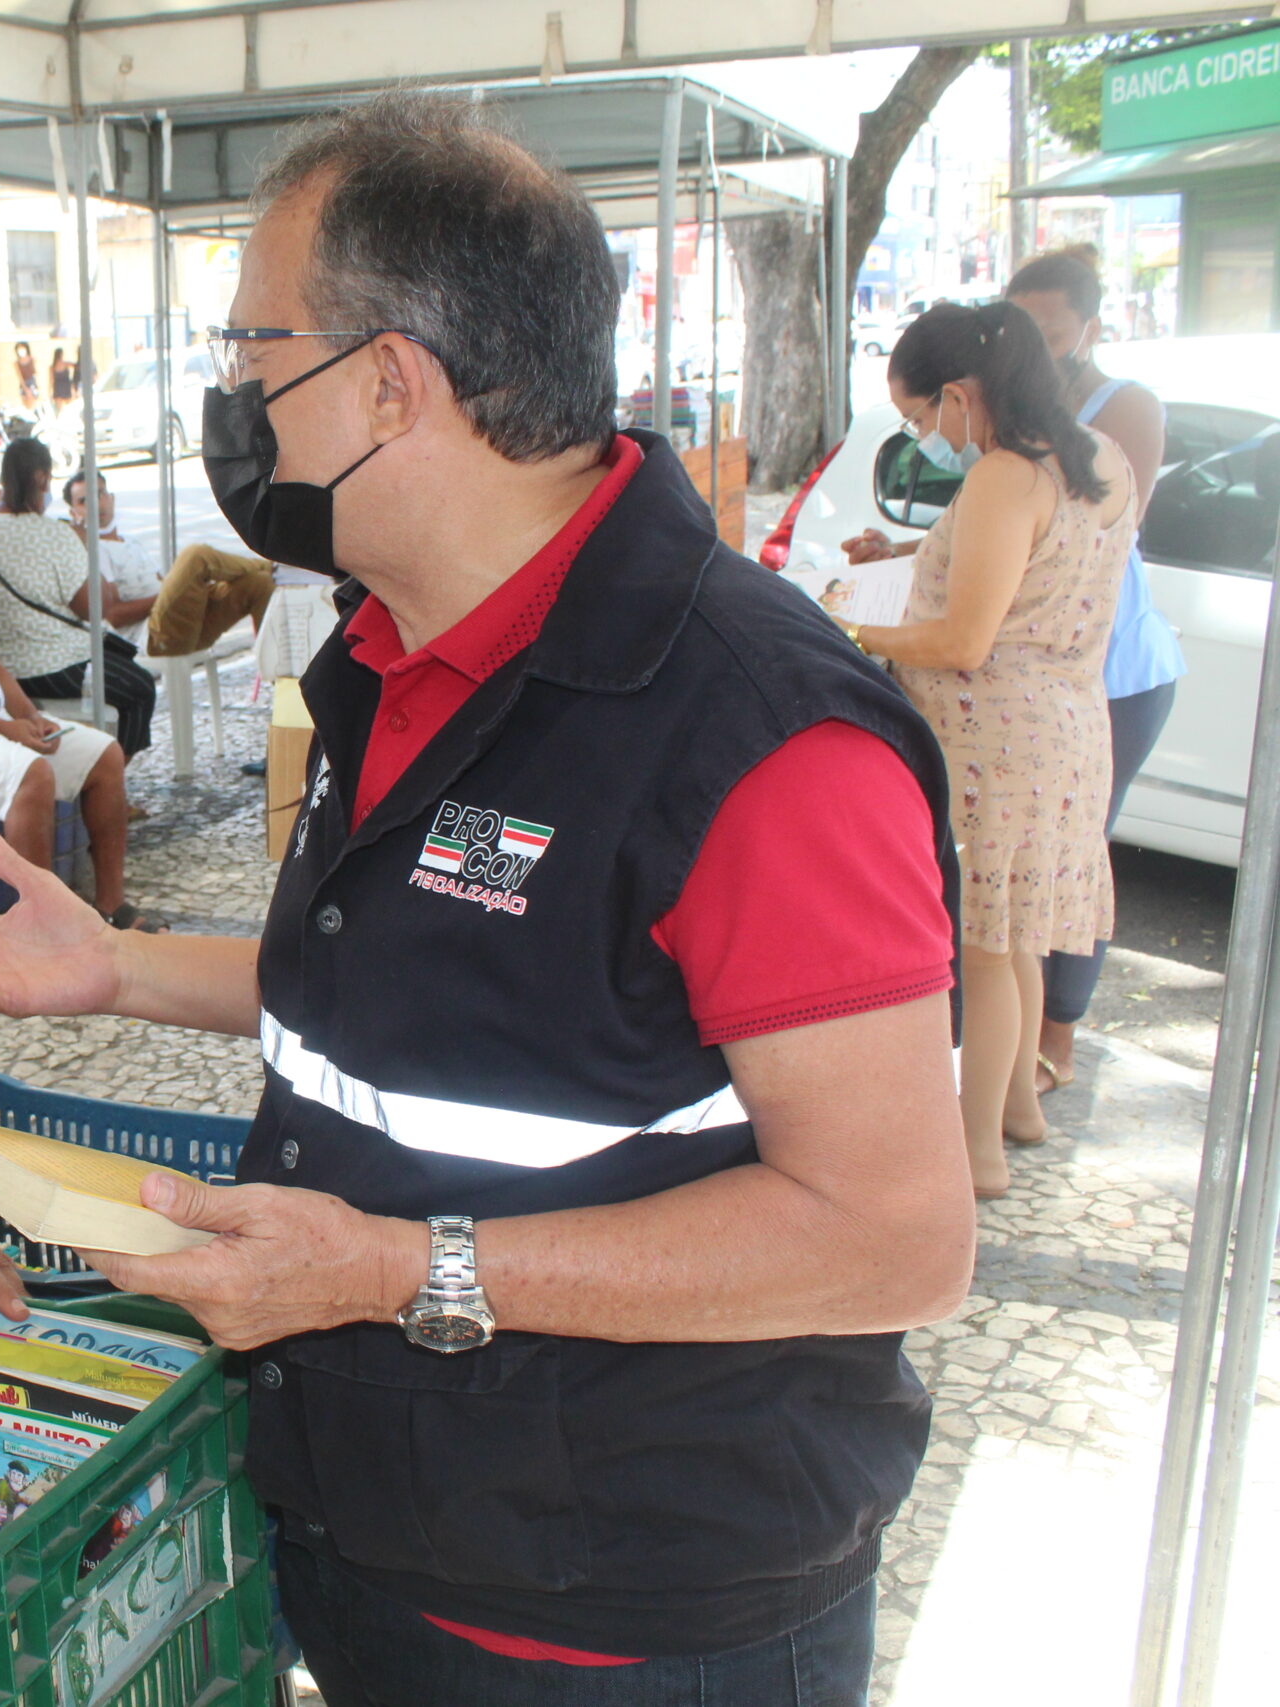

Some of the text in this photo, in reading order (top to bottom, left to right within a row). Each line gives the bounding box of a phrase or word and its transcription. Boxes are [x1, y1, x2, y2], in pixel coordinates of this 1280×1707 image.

[1110, 42, 1280, 105] BANCA CIDREI
[431, 799, 501, 845] PRO
[461, 844, 538, 890] CON
[408, 868, 527, 916] FISCALIZAÇÃO
